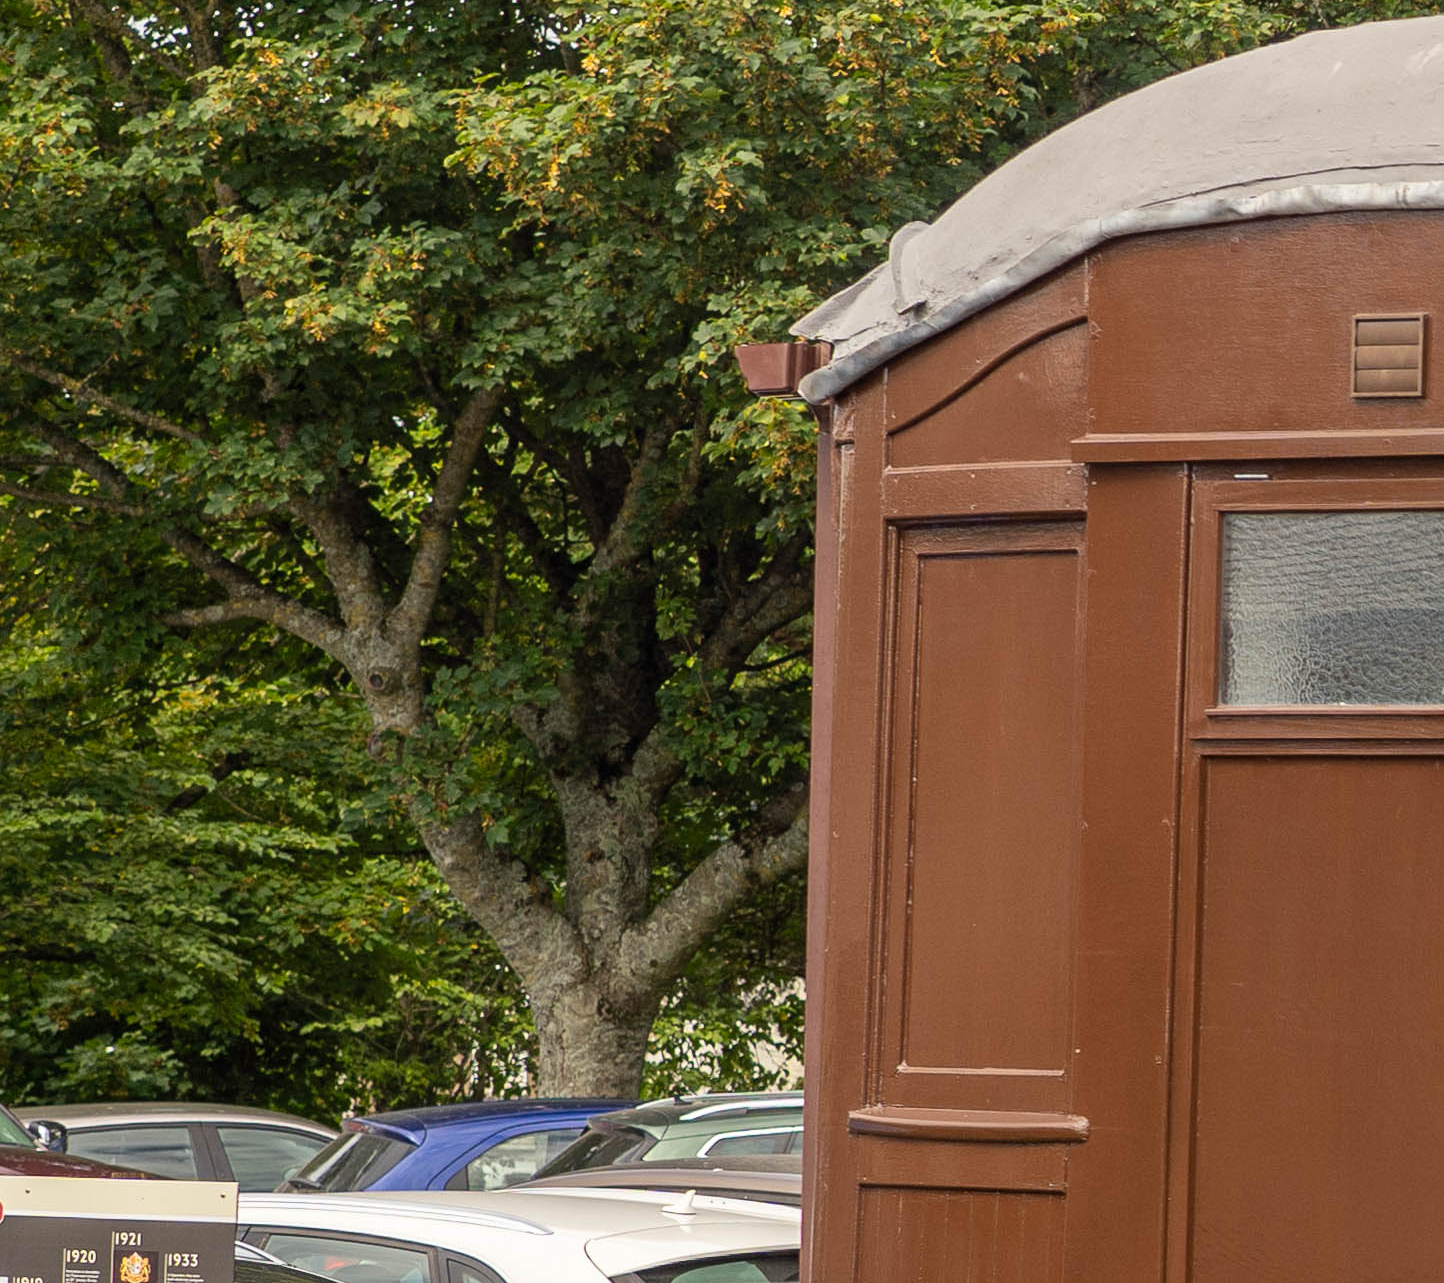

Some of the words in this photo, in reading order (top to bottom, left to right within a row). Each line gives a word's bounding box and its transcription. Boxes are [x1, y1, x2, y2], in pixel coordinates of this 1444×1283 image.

[115, 1232, 142, 1246] 1921
[66, 1249, 97, 1264] 1920
[168, 1253, 198, 1267] 1933
